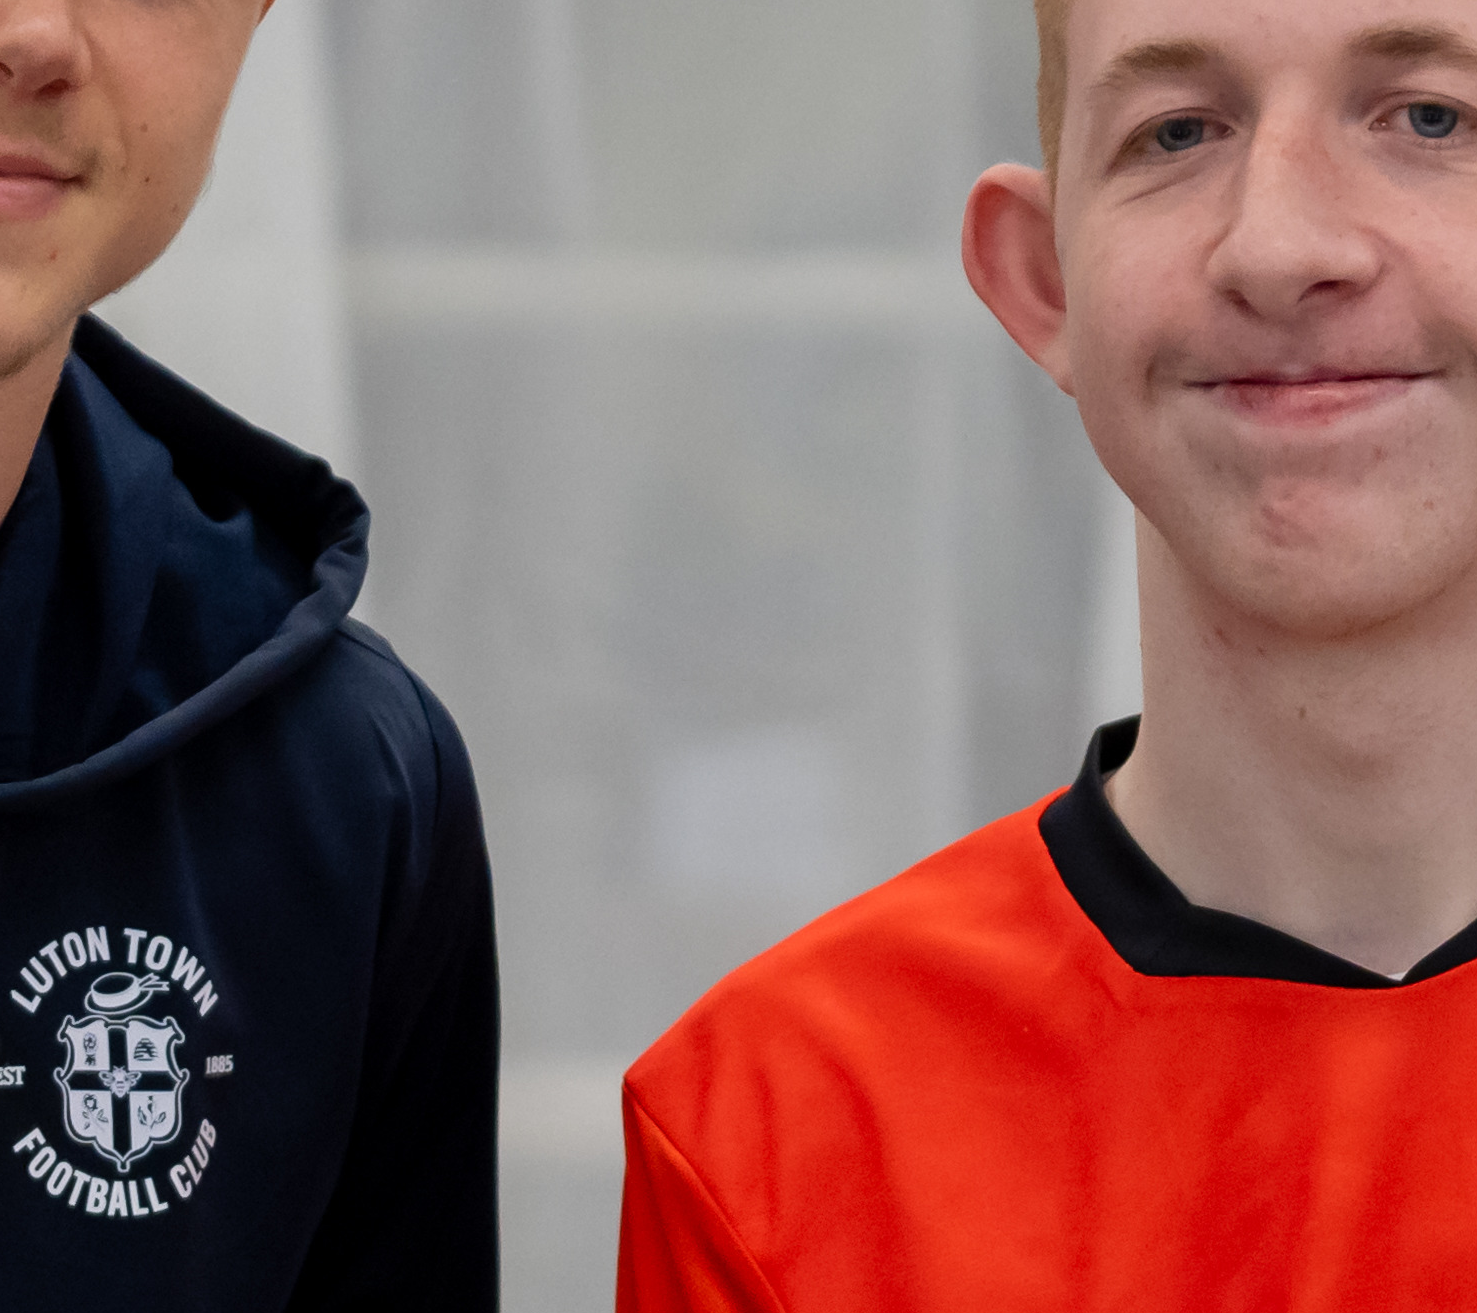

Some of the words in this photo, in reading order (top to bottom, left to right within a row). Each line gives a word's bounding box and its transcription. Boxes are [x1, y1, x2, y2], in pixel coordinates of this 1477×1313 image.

[10, 926, 111, 1014] LUTON
[123, 927, 219, 1017] TOWN
[205, 1054, 234, 1075] 1885
[12, 1127, 168, 1217] FOOTBALL
[169, 1118, 217, 1198] CLUB
